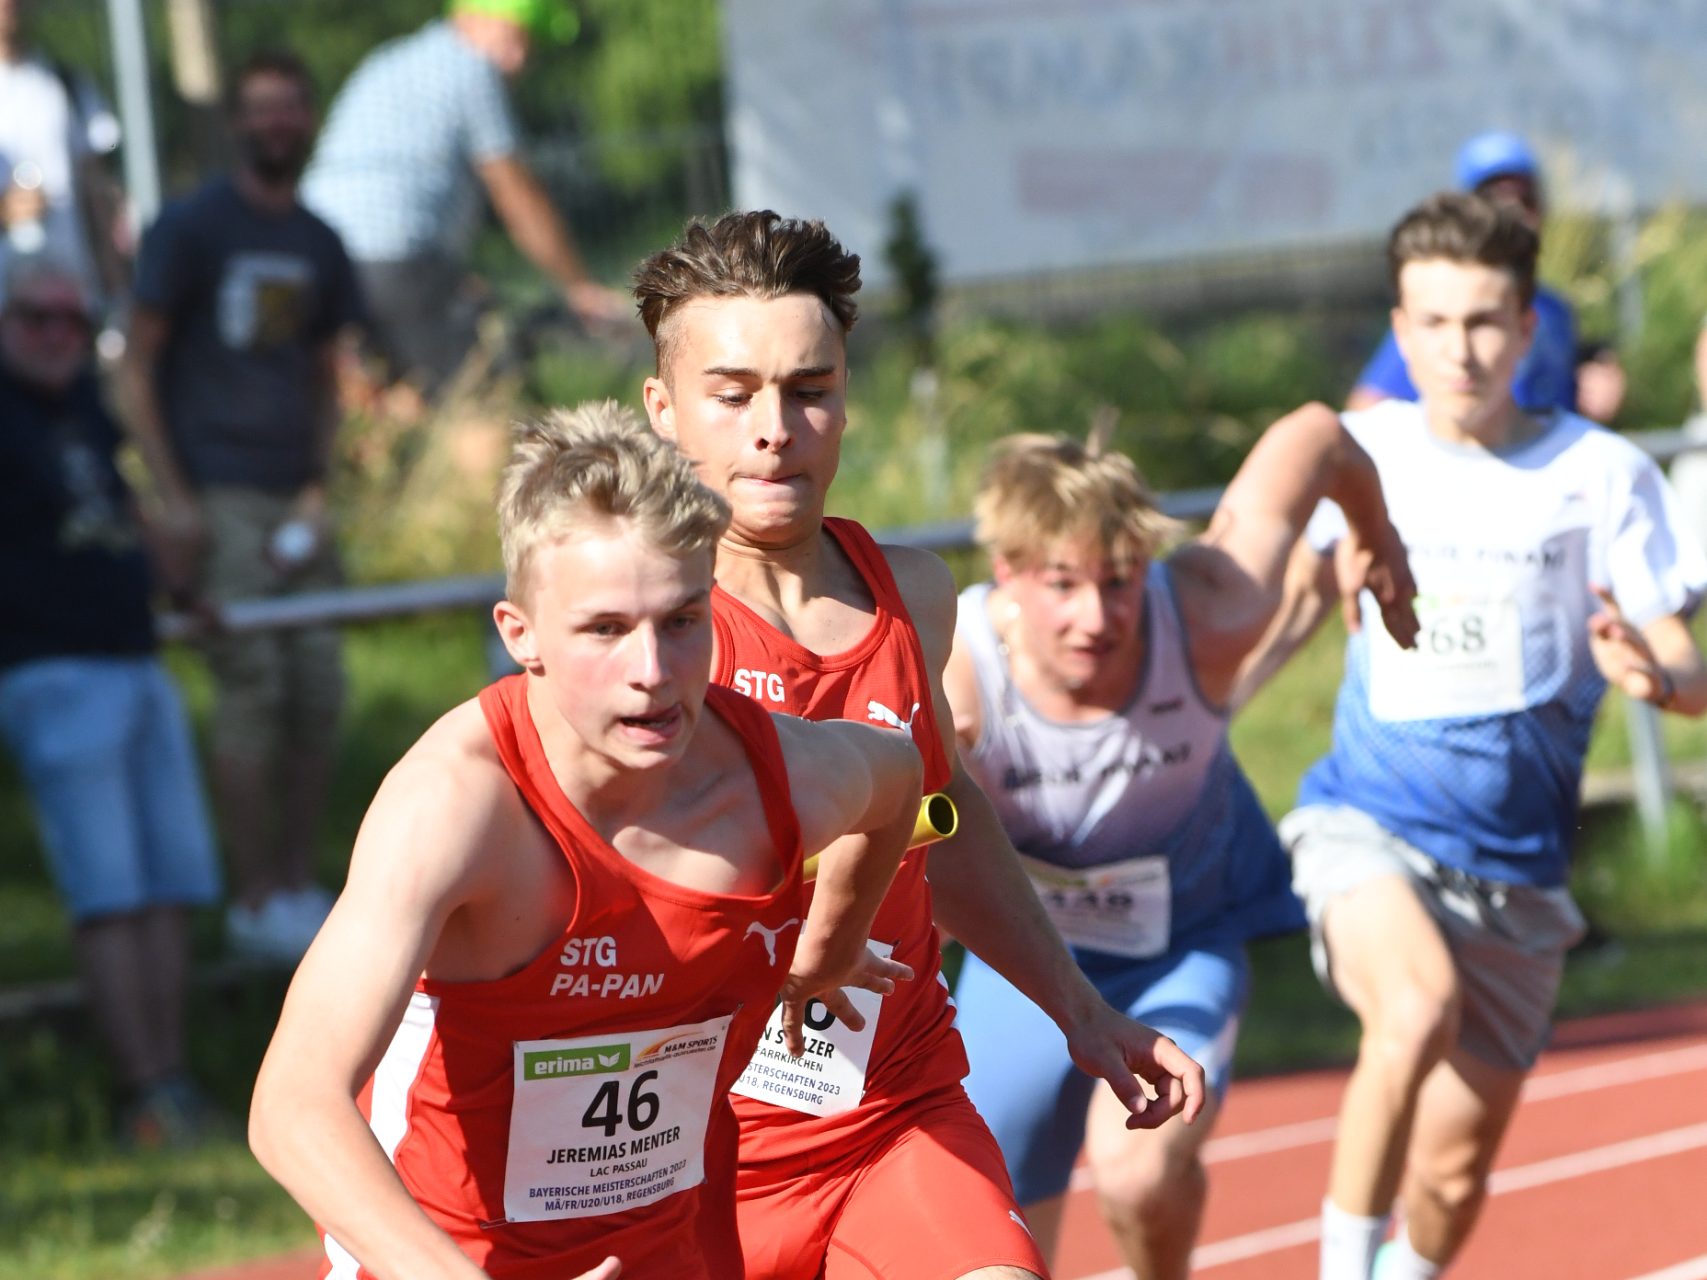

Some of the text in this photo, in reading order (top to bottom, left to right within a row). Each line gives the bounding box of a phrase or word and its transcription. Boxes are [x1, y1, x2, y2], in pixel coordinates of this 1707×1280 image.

[734, 668, 785, 703] STG
[560, 935, 617, 968] STG
[549, 973, 665, 999] PA-PAN
[664, 1035, 718, 1054] M&M SPORTS
[534, 1055, 595, 1076] erima
[754, 1045, 824, 1073] FARRKIRCHEN
[762, 1079, 824, 1105] REGENSBURG
[817, 1081, 841, 1096] 2023
[581, 1069, 660, 1137] 46
[546, 1126, 681, 1164] JEREMIAS MENTER
[590, 1158, 648, 1178] LAC PASSAU
[529, 1184, 590, 1199] BAYERISCHE
[592, 1167, 668, 1194] MEISTERSCHAFTEN
[626, 1176, 675, 1201] REGENSBURG
